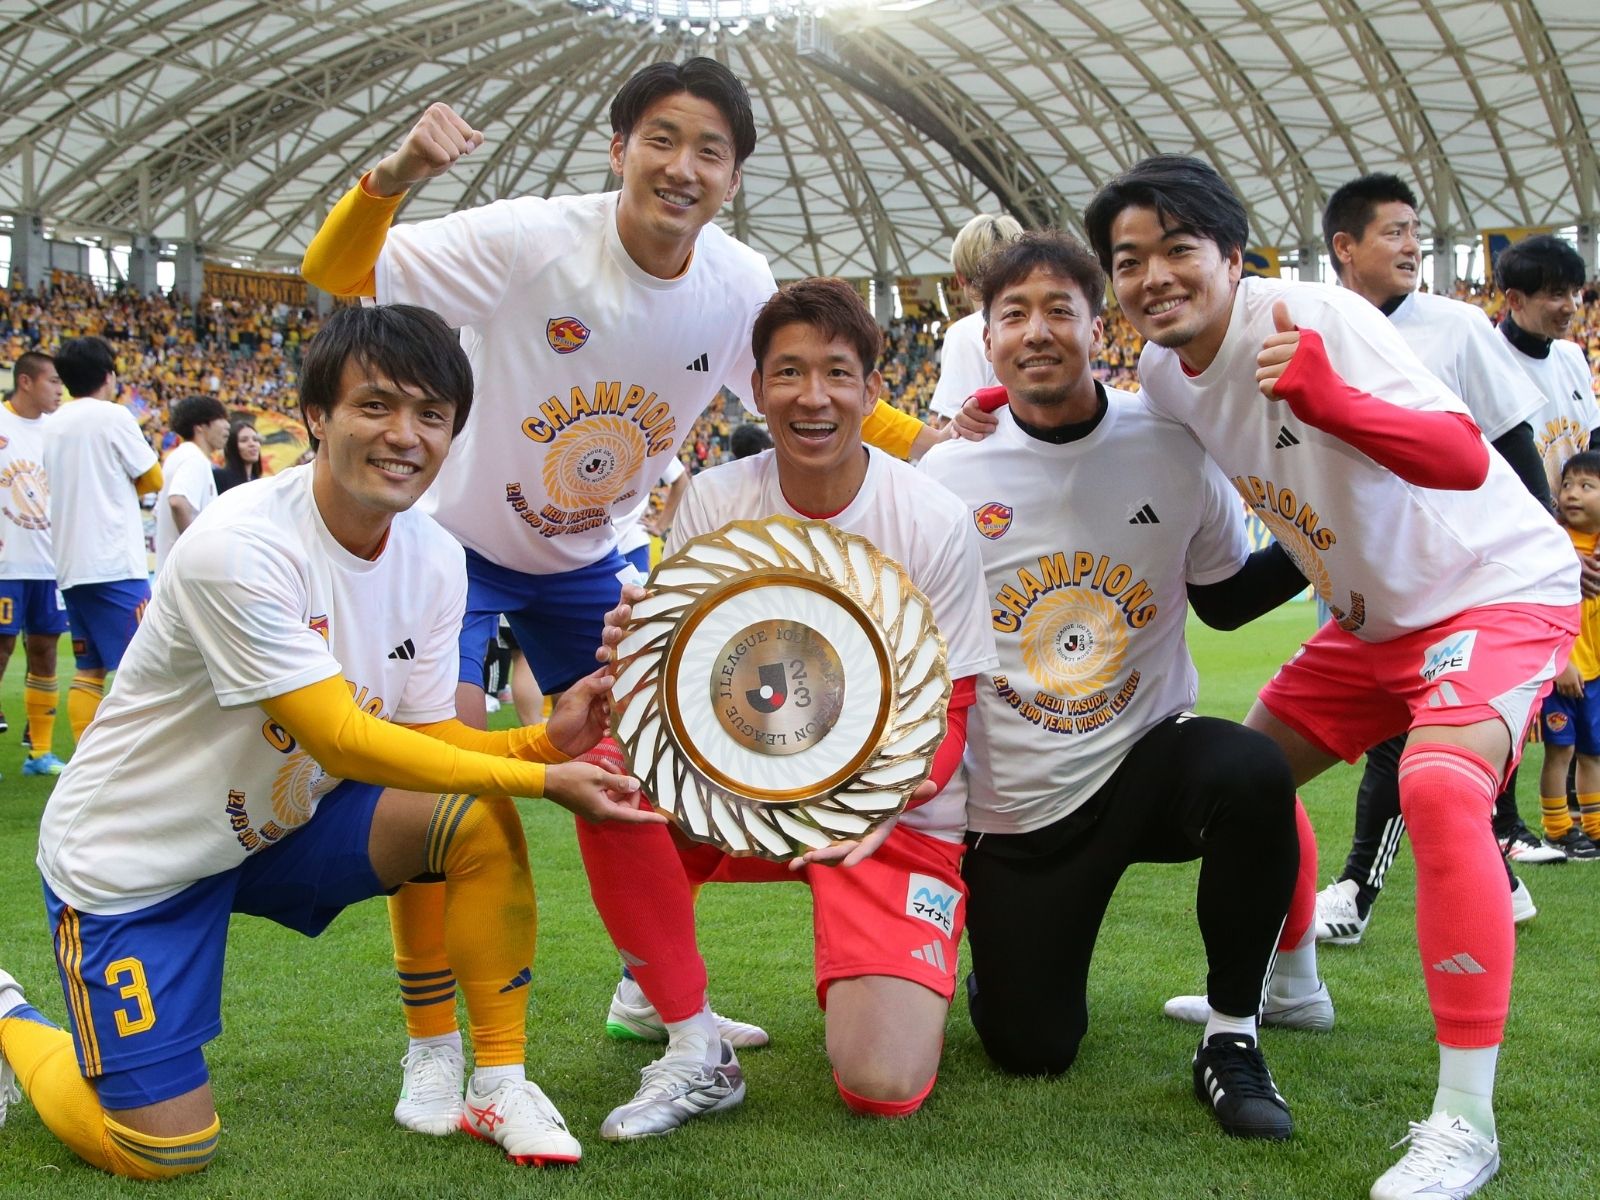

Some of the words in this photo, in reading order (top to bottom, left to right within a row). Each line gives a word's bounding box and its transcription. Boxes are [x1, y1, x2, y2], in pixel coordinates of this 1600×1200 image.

[521, 381, 677, 458] CHAMPIONS
[520, 509, 543, 528] 100
[991, 551, 1157, 634] CHAMPIONS
[720, 630, 768, 699] J.LEAGUE
[725, 706, 787, 746] LEAGUE
[1018, 702, 1042, 725] 100
[1043, 713, 1073, 734] YEAR
[1075, 707, 1114, 734] VISION
[1110, 668, 1142, 716] LEAGUE
[1034, 690, 1064, 714] MEIJI
[1067, 690, 1109, 716] YASUDA
[237, 827, 261, 852] 100
[912, 902, 951, 931] マイナビ
[104, 957, 157, 1039] 3
